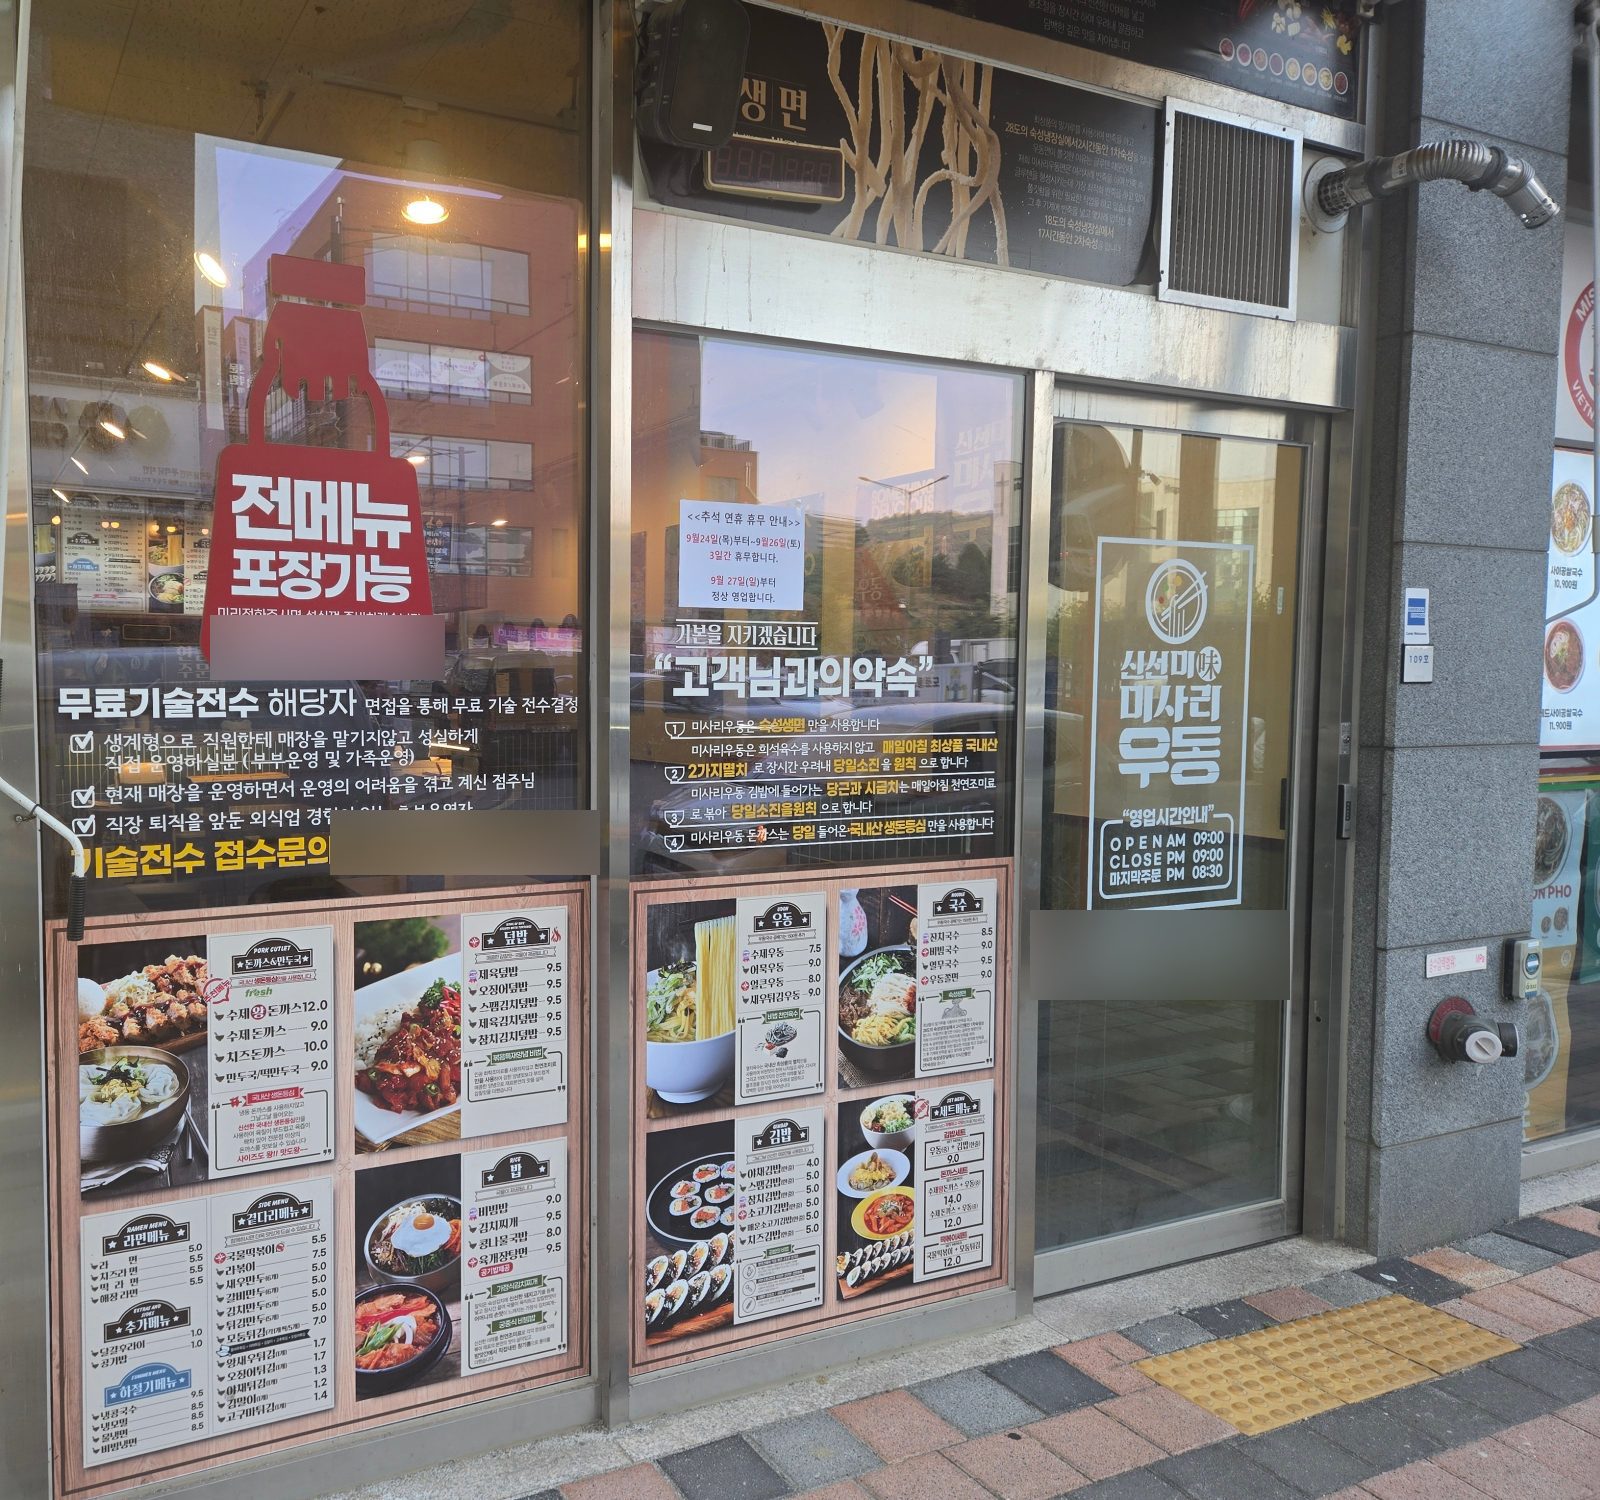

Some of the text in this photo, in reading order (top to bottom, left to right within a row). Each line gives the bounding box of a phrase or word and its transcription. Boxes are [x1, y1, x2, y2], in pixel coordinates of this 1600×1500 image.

[1005, 122, 1028, 137] 28도의
[1044, 215, 1066, 228] 18도의
[231, 473, 412, 549] 전메뉴
[687, 511, 720, 524] <<추석
[724, 512, 743, 525] 연휴
[747, 513, 766, 526] 휴무
[709, 551, 779, 563] 3일간 휴무합니다.
[231, 549, 412, 603] 포장가능
[1550, 566, 1583, 577] 사이공쌀국수
[710, 575, 776, 588] 9월 27일(일)부터
[711, 591, 776, 604] 정상 영업합니다.
[675, 623, 817, 646] 기본을 지키겠습니다
[654, 652, 933, 699] “고객님과의약속”
[58, 687, 578, 719] 무료기술전수 해당자 면접을 통해 무료 기술 전수결정
[1119, 684, 1222, 723] 미사리
[692, 718, 880, 733] 미사리우동은 숙성생면 만을 사용합니다
[104, 728, 478, 752] 생계형으로 직원한테 매장을 맡기지않고 성실하게
[691, 738, 998, 757] 미사리우동은 희석육수를 사용하지 않고 매일아침 최상품 국내산
[105, 749, 415, 773] 직접 운영하실분 (부부운영 및 가족운영)
[1118, 725, 1221, 788] 우동
[688, 756, 968, 779] 2가지멸치 장시간 우려내 당일소진 원칙 합니다
[105, 772, 535, 804] 현재 매장을 운영하면서 운영의 어려움을 겪고 계신 점주님
[691, 786, 745, 800] 미사리우동
[748, 785, 779, 799] 김밥에
[781, 784, 823, 797] 들어가는
[826, 780, 862, 797] 당근과
[911, 778, 949, 793] 매일아침
[951, 778, 997, 791] 천연조미료
[704, 800, 872, 820] 볶아 당일소진을원칙 합니다
[1123, 804, 1214, 828] “영업시간안내”
[105, 815, 143, 835] 직장
[148, 813, 204, 833] 퇴직을
[208, 811, 244, 831] 앞둔
[250, 809, 300, 827] 외식업
[690, 830, 745, 844] 미사리우동
[792, 825, 816, 840] 당일
[818, 824, 848, 839] 들어온
[850, 821, 883, 837] 국내산
[884, 819, 926, 835] 생돈등심
[928, 819, 947, 832] 만을
[949, 817, 994, 831] 사용합니다
[1110, 831, 1224, 851] OPEN AM 09:00
[214, 835, 331, 871] 접수문의
[1109, 848, 1224, 869] CLOSE PM 09:00
[1109, 863, 1223, 886] 마지막주문 PM 08:30
[1549, 885, 1571, 898] PHO
[949, 898, 967, 912] 국수
[772, 912, 793, 927] 우동
[504, 930, 528, 945] 덮밥
[254, 946, 269, 954] PORK
[930, 941, 992, 956] 비빔국수 9.0
[245, 955, 301, 969] 돈까스&만두국
[479, 963, 561, 980] 제육덮밥 9.5
[750, 958, 821, 974] 어묵우동 9.0
[245, 987, 272, 998] fresh
[479, 979, 561, 996] 오징어덮밥 9.5
[226, 1040, 328, 1063] 치즈돈까스 10.0
[226, 1060, 328, 1083] 만두국/떡만두국 9.0
[940, 1103, 971, 1117] 세트메뉴
[770, 1128, 792, 1145] 김밥
[806, 1158, 819, 1167] 4.0
[479, 1194, 561, 1216] 비빔밥 9.0
[943, 1193, 962, 1205] 14.0
[247, 1206, 299, 1225] 곁다리메뉴
[480, 1211, 561, 1233] 김치찌개 9.5
[124, 1230, 170, 1247] 라면메뉴
[228, 1234, 327, 1261] 국물떡볶이 5.5
[225, 1248, 327, 1275] 라볶이 7.5
[481, 1264, 510, 1276] 공기밥제공
[125, 1316, 171, 1333] 추가메뉴
[120, 1377, 177, 1399] 하절기메뉴
